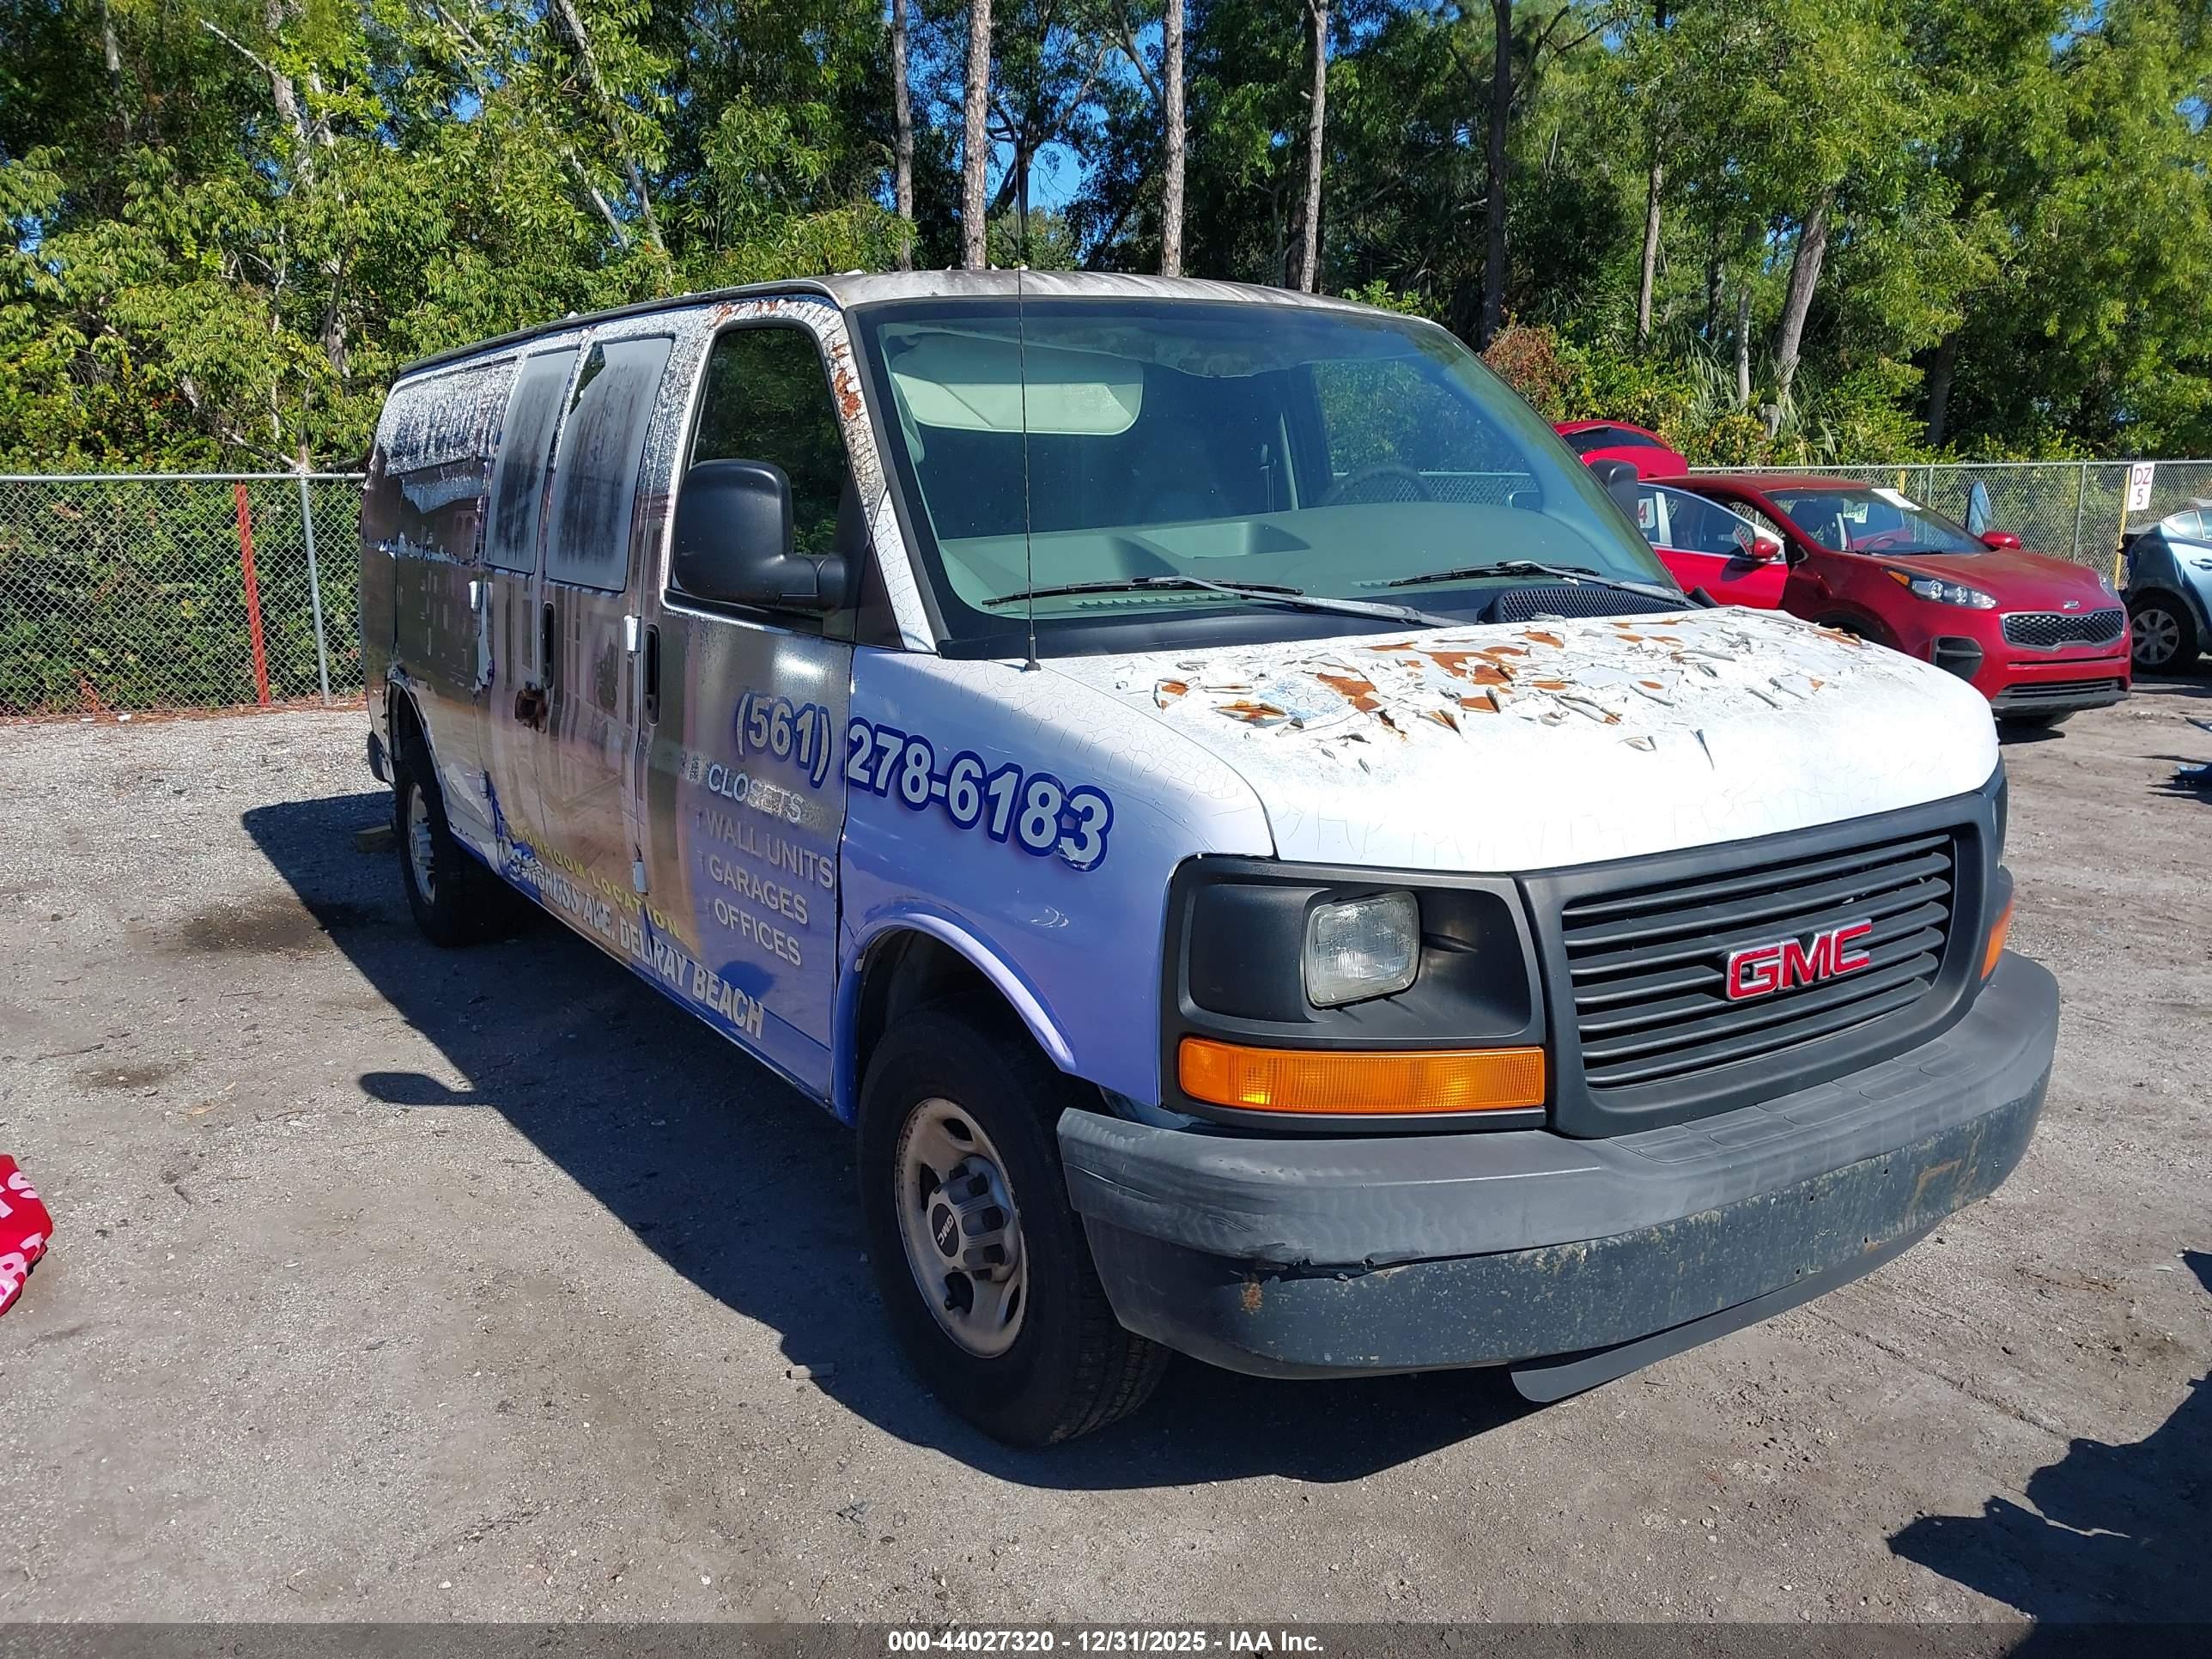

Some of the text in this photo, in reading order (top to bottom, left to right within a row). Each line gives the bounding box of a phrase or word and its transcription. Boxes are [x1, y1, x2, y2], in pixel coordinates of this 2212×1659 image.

[2134, 467, 2153, 485] DZ
[2136, 488, 2143, 506] 5
[708, 763, 805, 823] CLOSETS
[736, 691, 1114, 870] (561) 278-6183
[705, 807, 834, 889] WALL UNITS
[590, 870, 683, 940] LOCATION
[708, 854, 809, 926] GARAGES
[714, 897, 802, 967] OFFICES
[1726, 918, 1873, 1000] GMC
[618, 915, 688, 988] DELRAY
[691, 959, 764, 1041] BEACH
[937, 1213, 954, 1246] GMC
